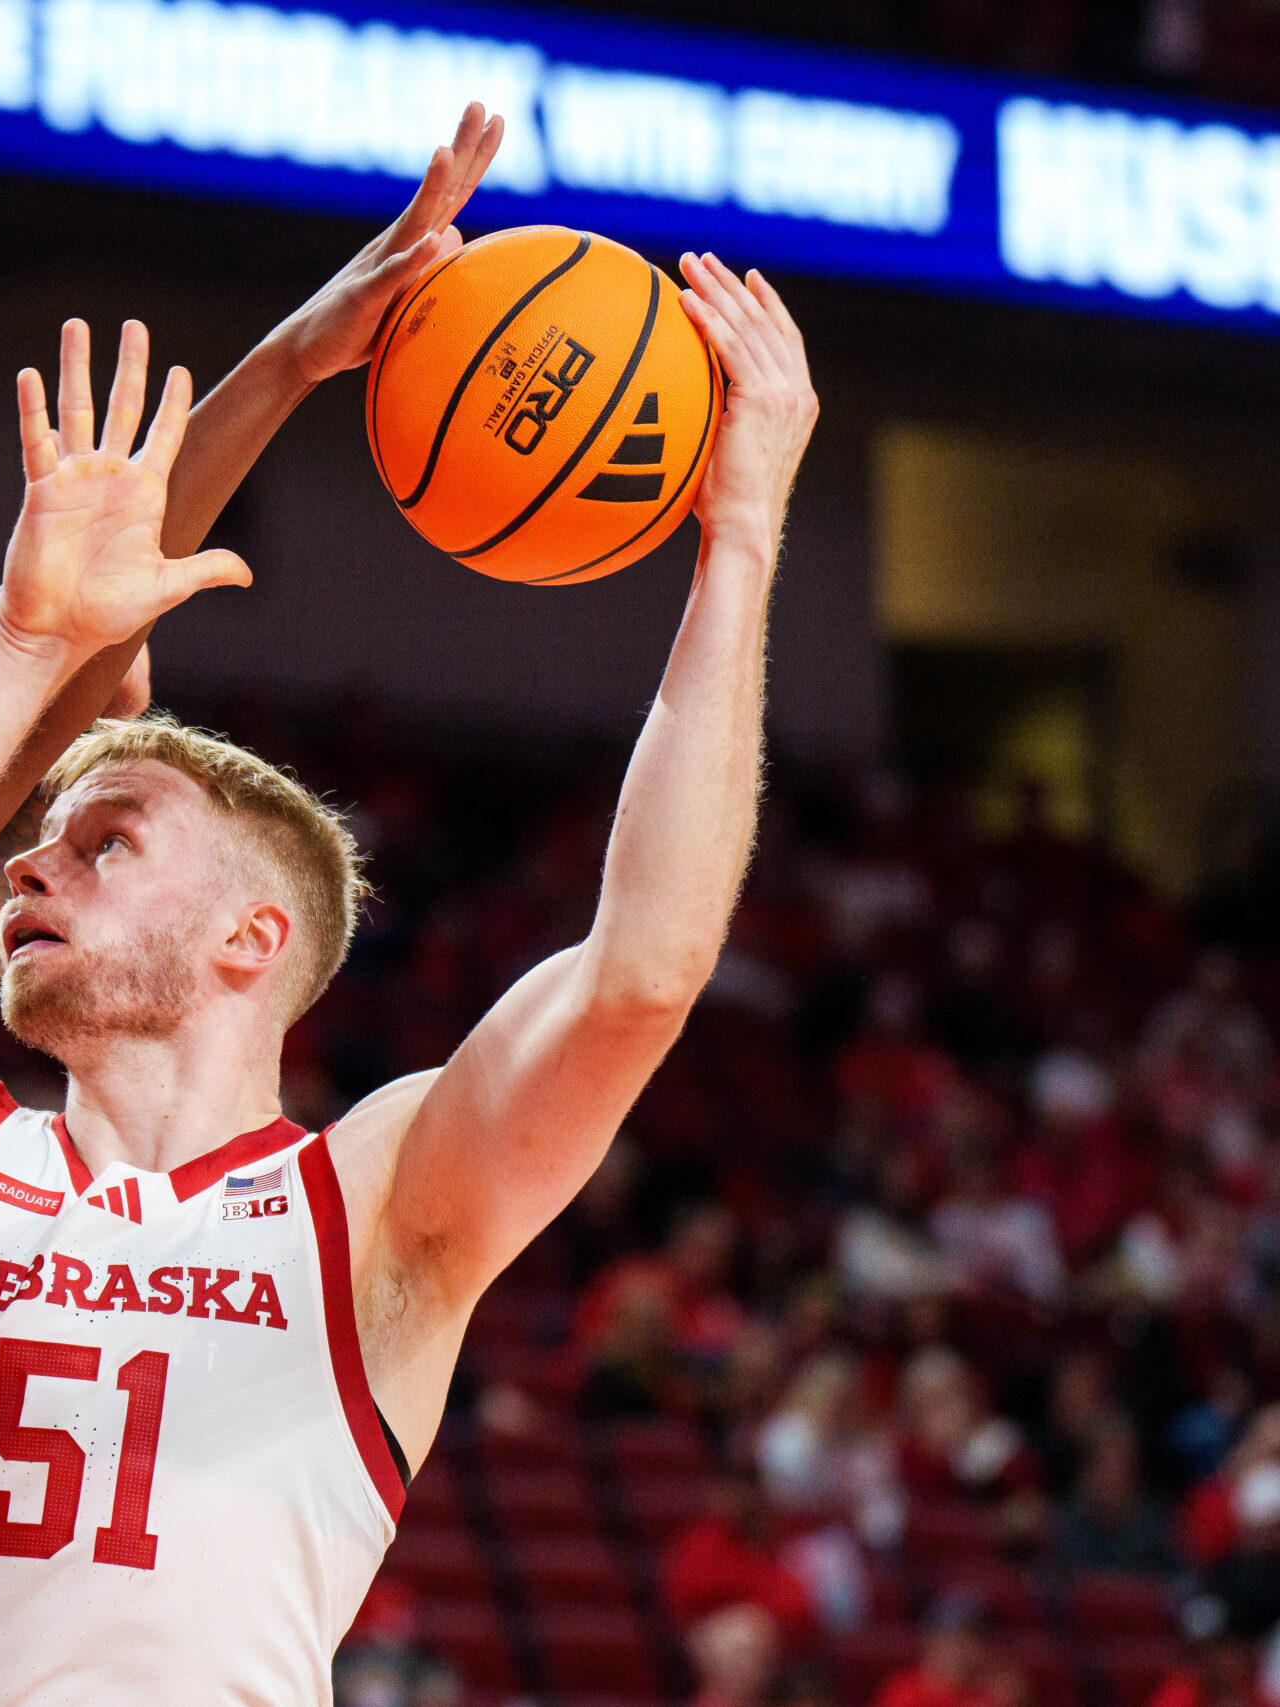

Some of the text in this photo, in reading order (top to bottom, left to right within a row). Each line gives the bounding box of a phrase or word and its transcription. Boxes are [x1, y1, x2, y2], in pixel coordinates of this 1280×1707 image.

[483, 325, 558, 429] OFFICIAL GAME BALL
[504, 337, 596, 456] PRO
